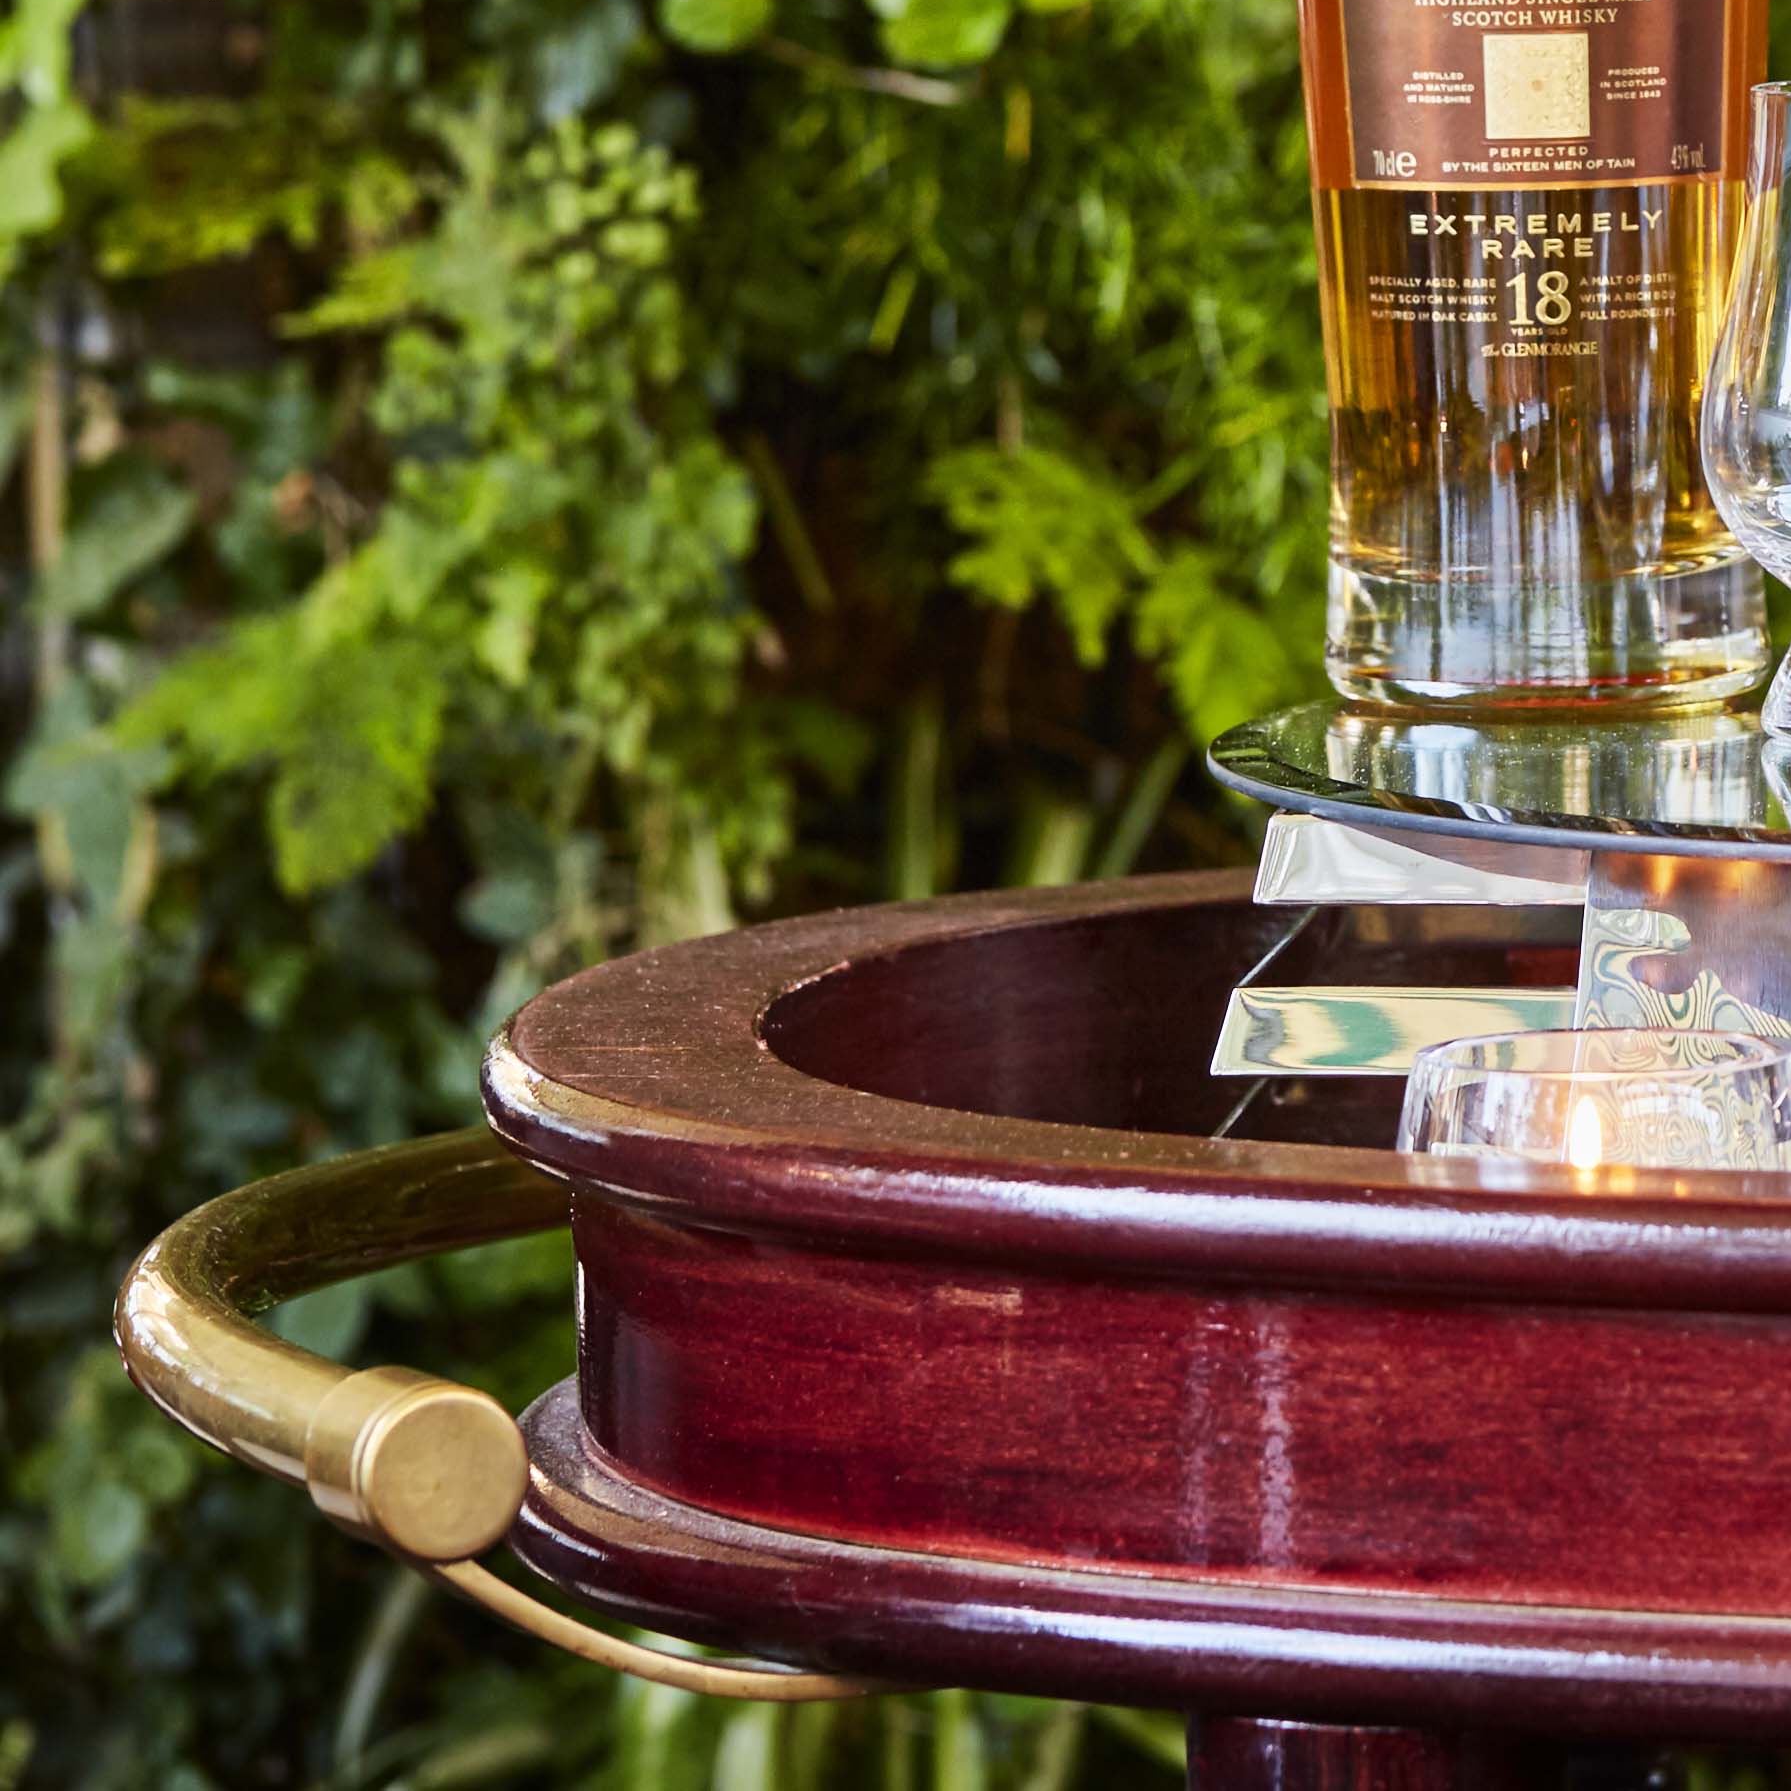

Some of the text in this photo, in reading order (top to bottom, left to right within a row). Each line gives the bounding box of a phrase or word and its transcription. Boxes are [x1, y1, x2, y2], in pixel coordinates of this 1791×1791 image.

[1452, 8, 1619, 27] SCOTCH WHISKY
[1488, 146, 1589, 158] PERFECTED
[1442, 158, 1635, 173] BY THE SIXTEEN MEN OF TAIN
[1409, 210, 1663, 236] EXTREMELY
[1481, 237, 1594, 260] RARE
[1447, 294, 1497, 306] WHISKY
[1505, 271, 1572, 327] 18
